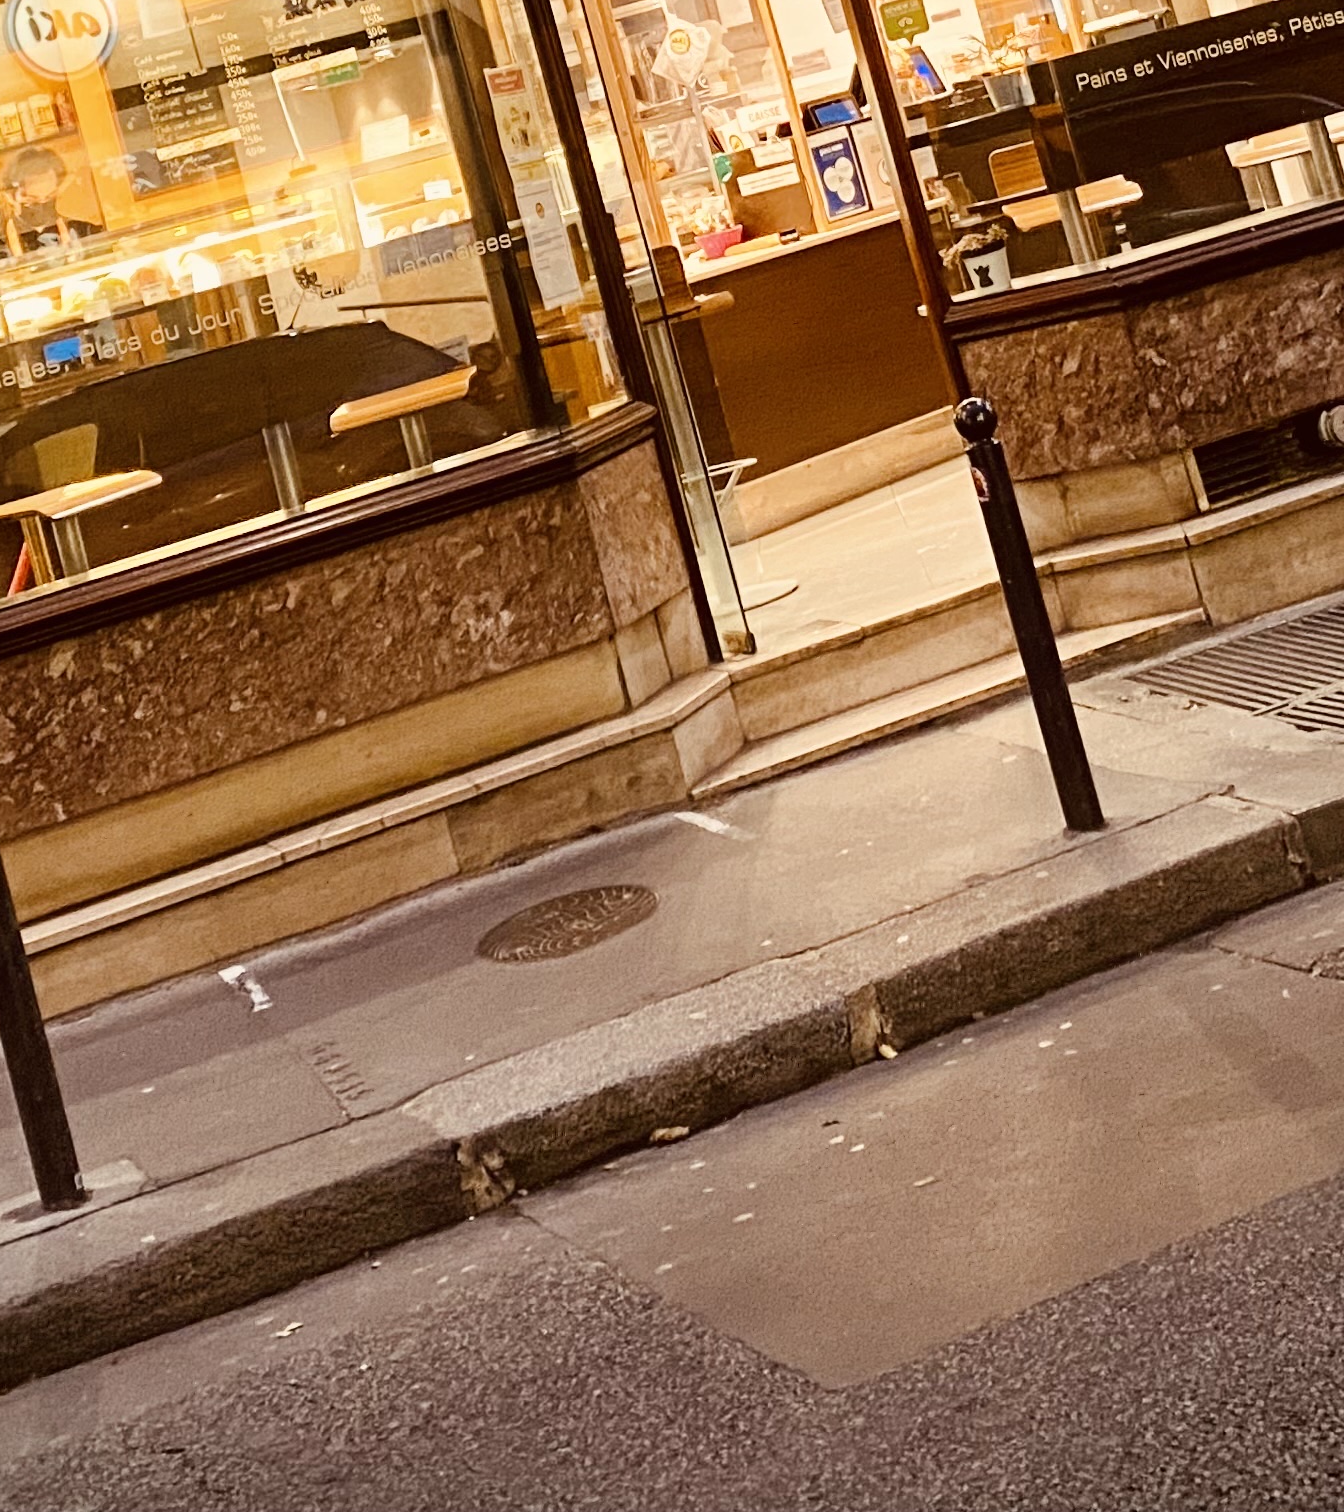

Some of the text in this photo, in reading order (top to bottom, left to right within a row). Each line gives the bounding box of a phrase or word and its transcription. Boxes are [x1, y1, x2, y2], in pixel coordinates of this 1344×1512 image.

[1075, 66, 1128, 92] Pains
[1133, 60, 1154, 77] et
[1156, 27, 1285, 71] Viennoiseries,
[79, 335, 142, 366] Plats
[151, 323, 180, 346] du
